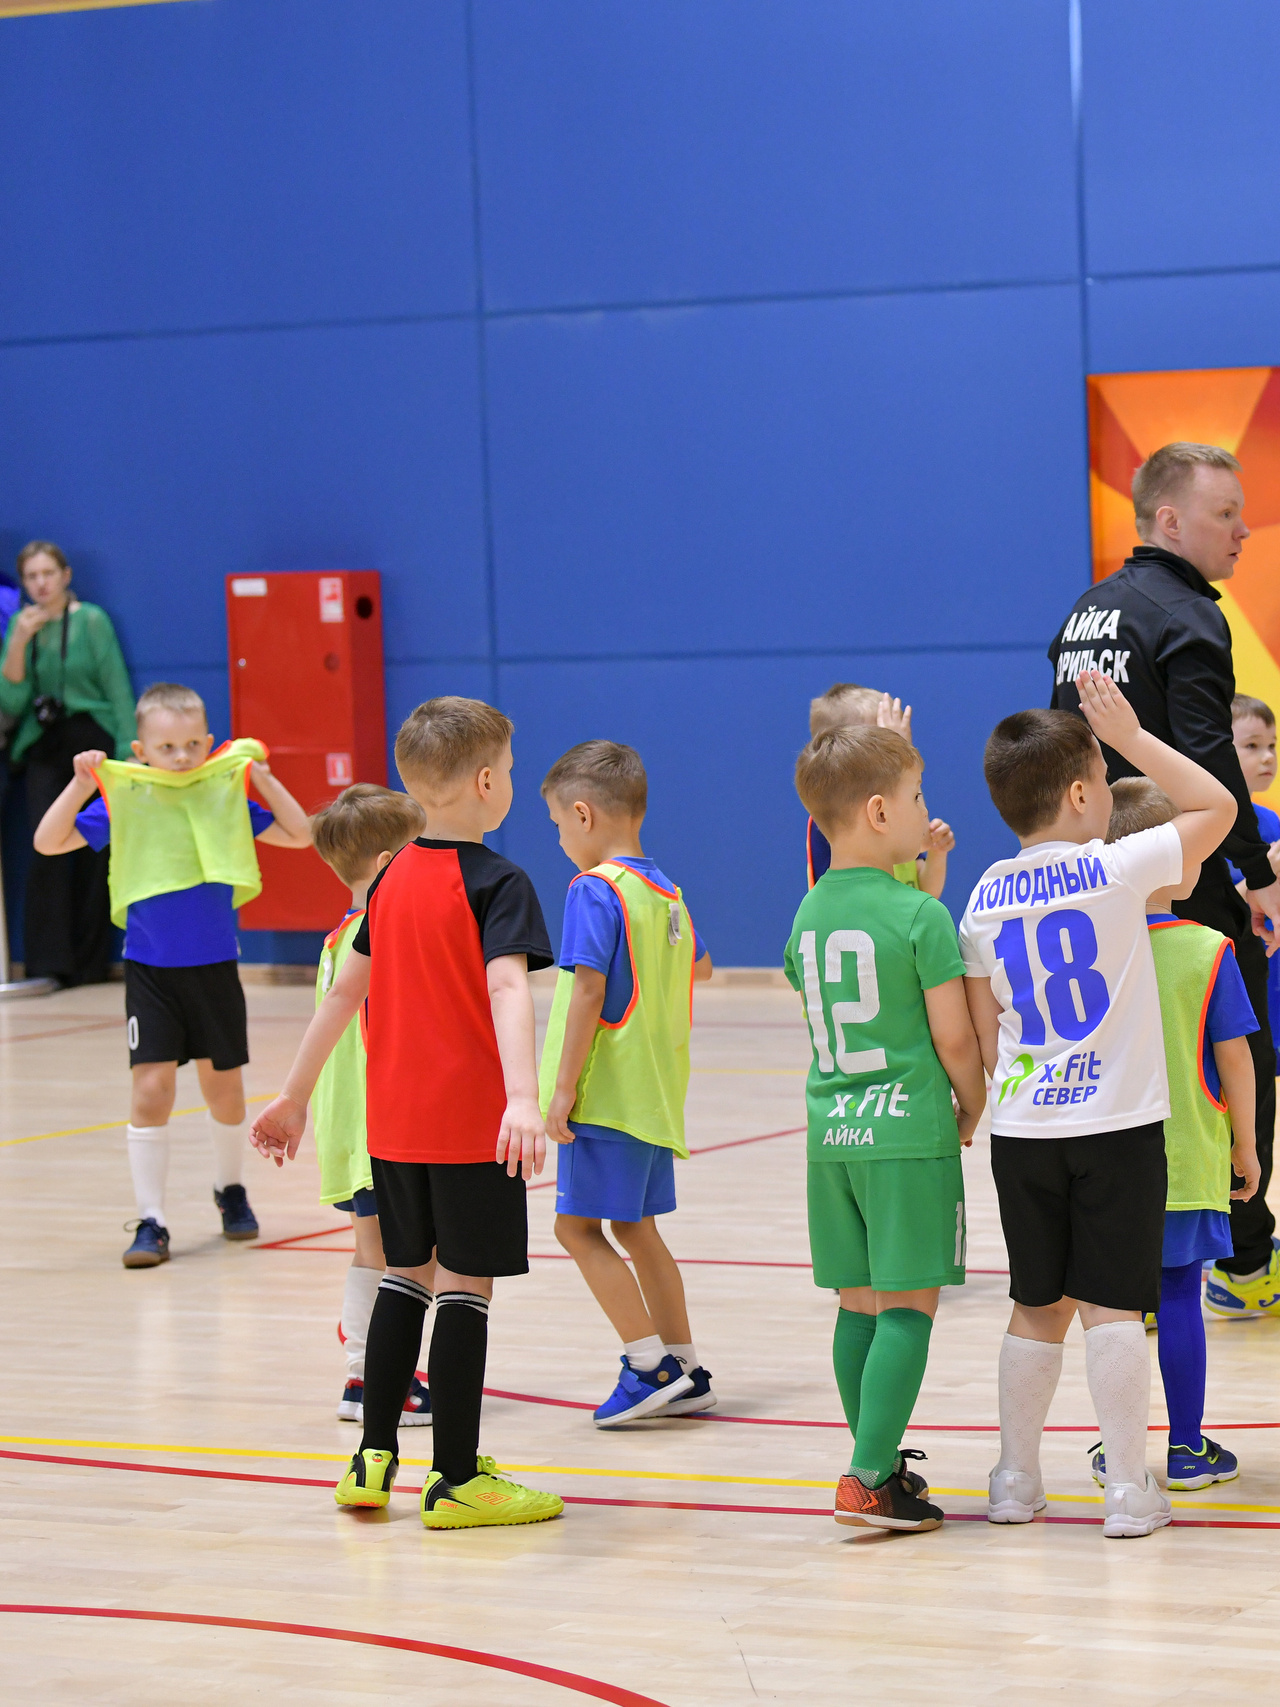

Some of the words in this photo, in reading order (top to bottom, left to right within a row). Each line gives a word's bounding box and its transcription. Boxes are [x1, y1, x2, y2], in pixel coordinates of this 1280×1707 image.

[1061, 605, 1121, 644] АЙКА
[1056, 648, 1131, 687] ОРИЛЬСК
[972, 852, 1108, 914] ХОЛОДНЫЙ
[993, 908, 1110, 1046] 18
[798, 929, 888, 1075] 12
[1032, 1085, 1098, 1106] СЕВЕР
[822, 1124, 875, 1146] АЙКА
